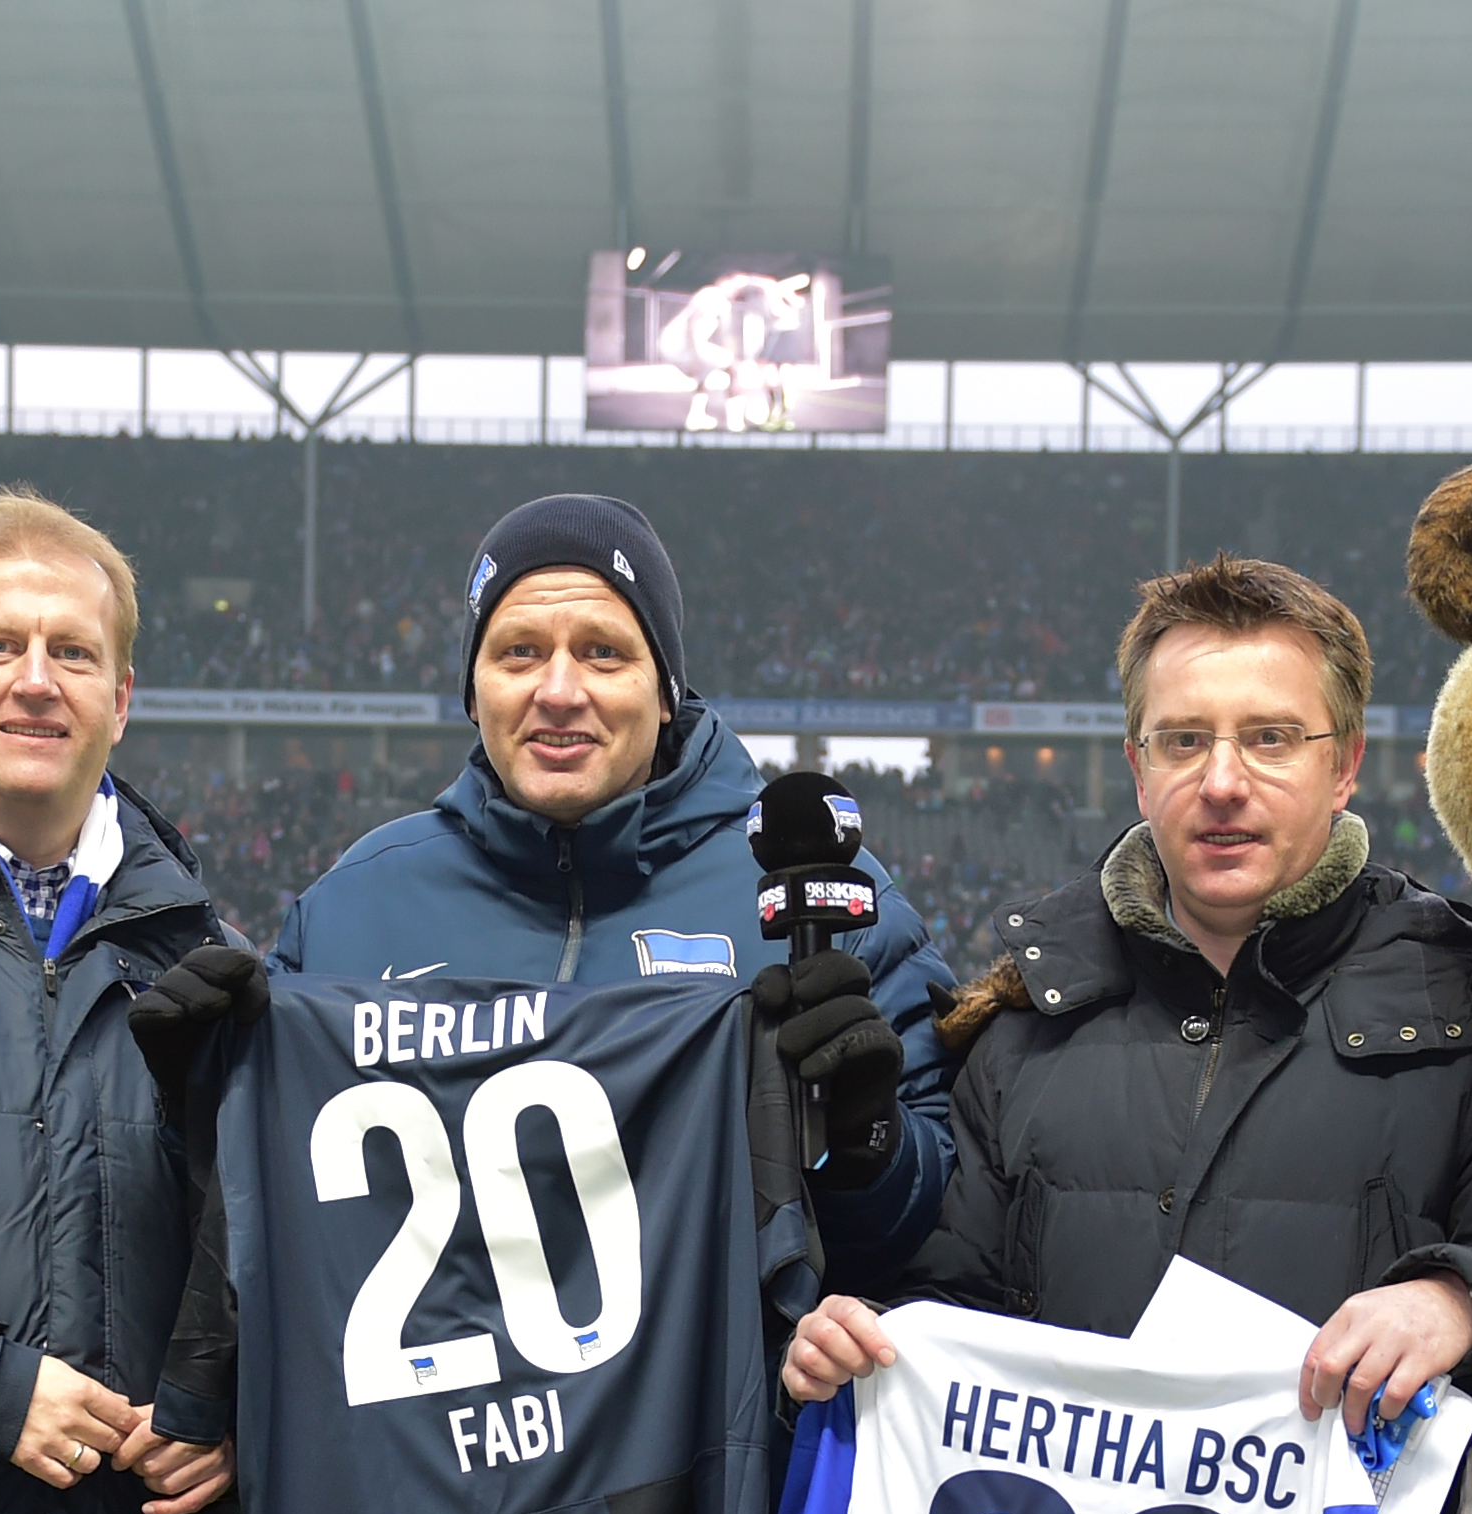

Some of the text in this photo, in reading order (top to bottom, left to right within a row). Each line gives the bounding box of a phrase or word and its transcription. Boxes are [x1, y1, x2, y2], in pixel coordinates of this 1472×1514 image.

[353, 991, 548, 1067] BERLIN
[310, 1060, 642, 1406] 20
[448, 1389, 566, 1473] FABI
[942, 1381, 1305, 1509] HERTHA BSC
